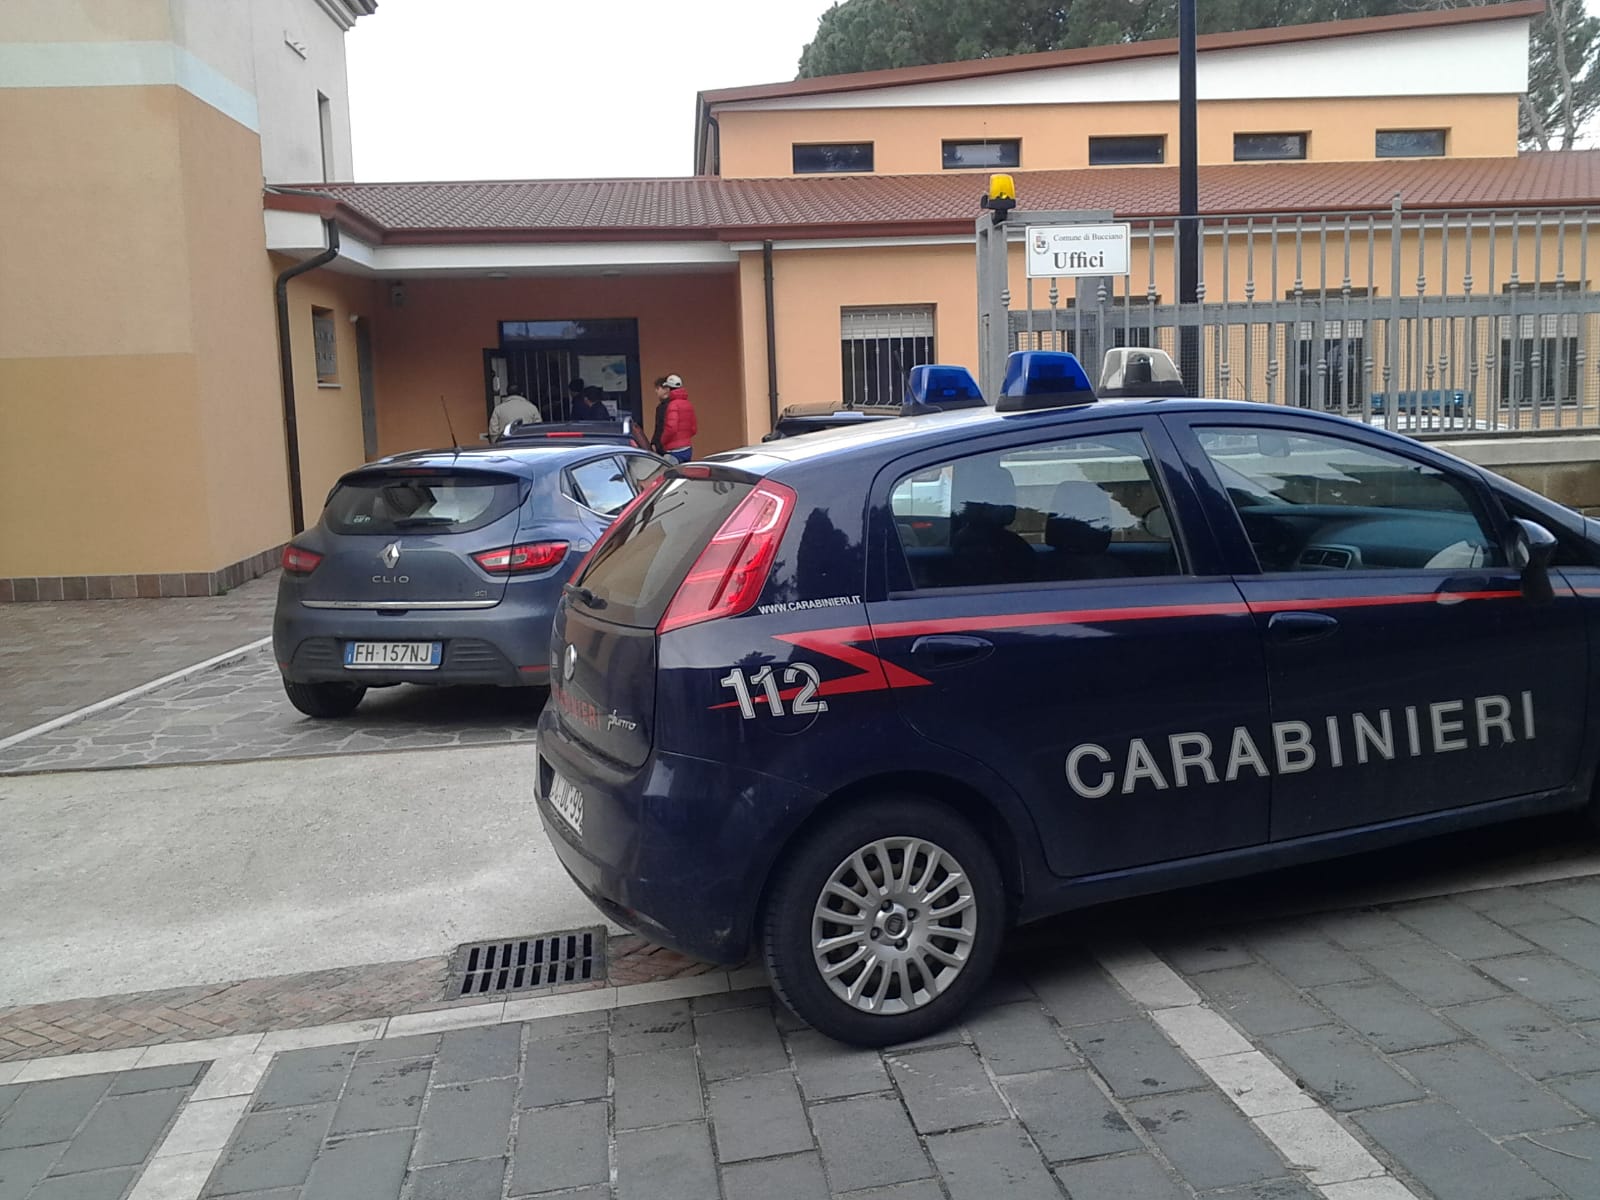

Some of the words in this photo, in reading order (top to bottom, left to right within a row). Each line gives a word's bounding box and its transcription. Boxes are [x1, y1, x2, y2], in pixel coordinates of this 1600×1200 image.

[1053, 234, 1081, 242] Comune
[1083, 233, 1090, 241] di
[1092, 232, 1123, 241] Bucciano
[1053, 251, 1104, 269] Uffici
[372, 575, 409, 583] CLIO
[758, 595, 861, 614] WWW.CARABINIERI.IT
[720, 662, 829, 719] 112
[1065, 690, 1536, 799] CARABINIERI
